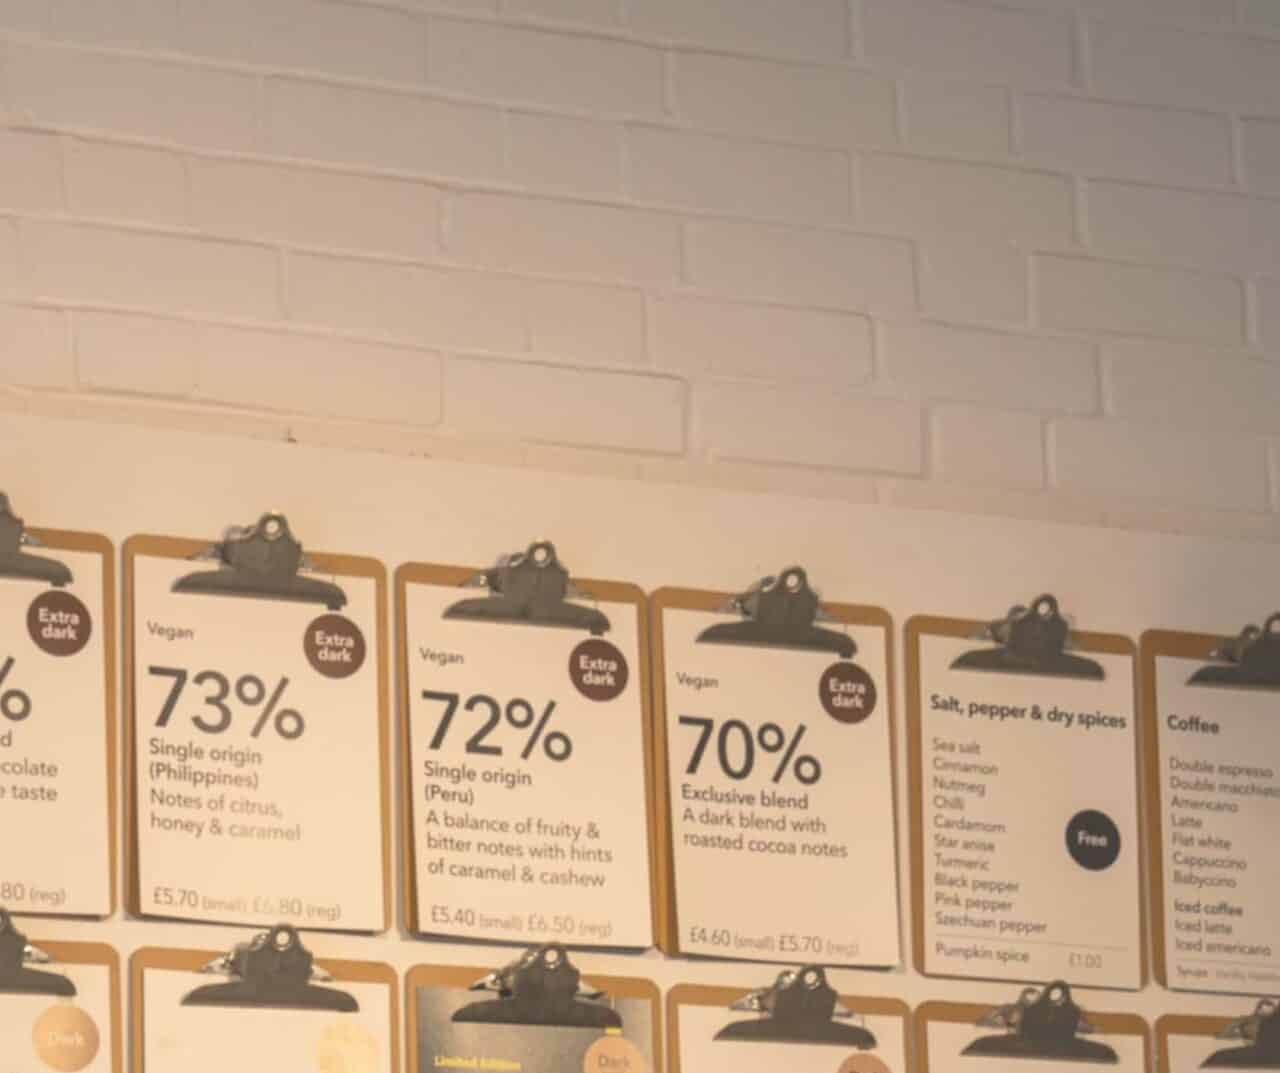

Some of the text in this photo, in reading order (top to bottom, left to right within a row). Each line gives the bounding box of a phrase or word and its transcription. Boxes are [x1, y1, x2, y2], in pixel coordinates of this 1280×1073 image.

[148, 665, 304, 740] 73%
[931, 694, 1126, 730] Salt, pepper & dry spices
[422, 690, 572, 762] 72%
[1168, 714, 1219, 735] Coffee
[149, 737, 261, 768] Single origin
[679, 715, 821, 789] 70%
[1168, 758, 1216, 775] Double
[149, 760, 257, 789] (Philippines)
[425, 783, 474, 806] (Peru)
[680, 783, 808, 810] Exclusive blend
[427, 831, 612, 863] bitter notes with hints
[684, 831, 848, 860] roasted cocoa notes
[1170, 832, 1231, 851] Flat white
[936, 941, 1030, 964] Pumpkin spice
